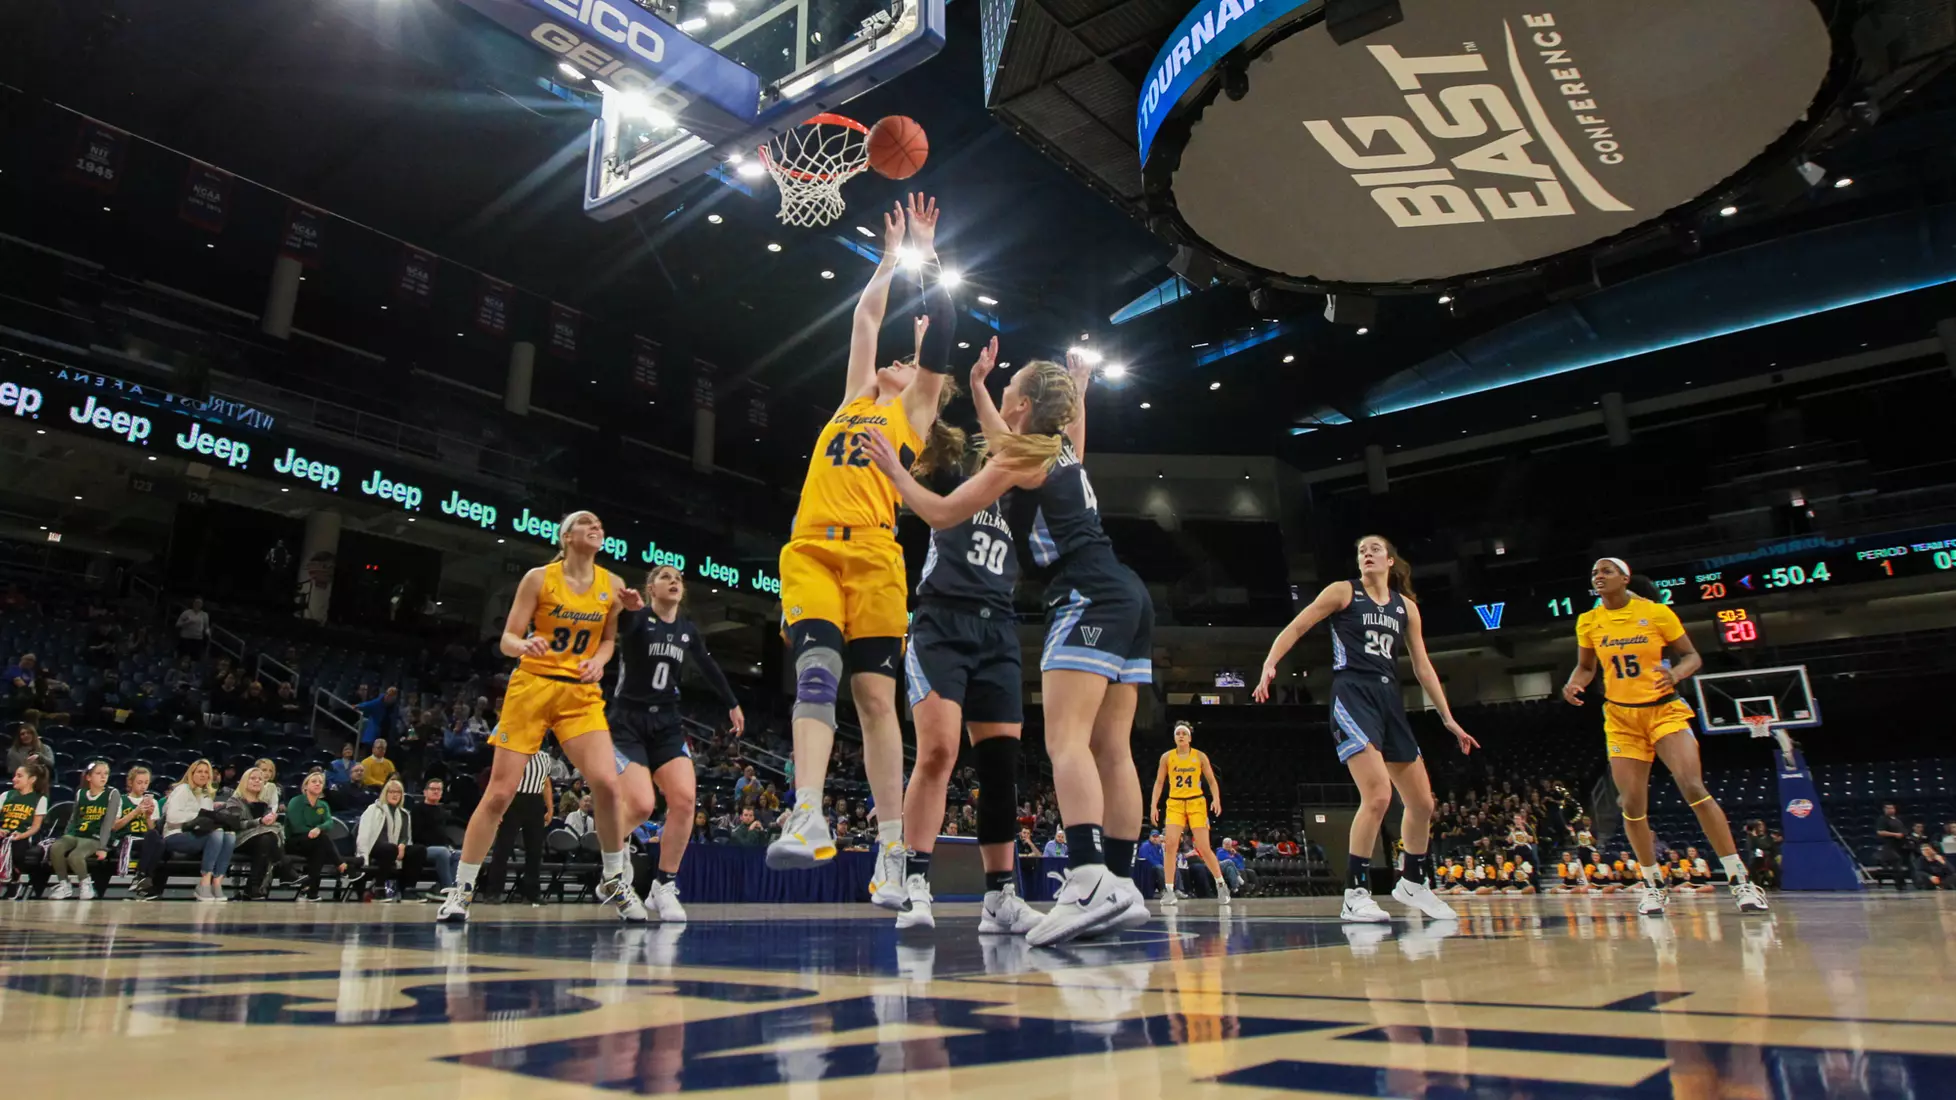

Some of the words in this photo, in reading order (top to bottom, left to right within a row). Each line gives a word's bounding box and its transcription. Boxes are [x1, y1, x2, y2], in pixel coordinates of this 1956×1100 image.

[531, 23, 690, 119] GEICO
[1522, 12, 1624, 165] CONFERENCE
[1366, 45, 1576, 220] EAST
[1303, 115, 1485, 228] BIG
[70, 396, 151, 443] Jeep
[177, 423, 250, 467] Jeep
[824, 431, 873, 467] 42
[274, 448, 341, 490] Jeep
[362, 470, 422, 510] Jeep
[441, 491, 497, 528] Jeep
[600, 536, 628, 561] ep
[642, 542, 686, 571] Jeep
[966, 530, 1008, 576] 30
[1856, 546, 1908, 561] PERIOD
[699, 556, 740, 588] Jeep
[1655, 576, 1686, 588] FOULS
[1695, 572, 1722, 583] SHOT
[1763, 561, 1831, 589] :50.4
[1880, 559, 1894, 576] 1
[752, 569, 781, 598] Jee
[1659, 588, 1675, 606] 2
[1700, 582, 1727, 600] 20
[1548, 596, 1573, 617] 11
[1362, 612, 1400, 634] VILLANOVA
[1725, 620, 1757, 642] 20
[550, 626, 591, 656] 30
[1364, 629, 1394, 660] 20
[1600, 634, 1648, 651] Marquette
[651, 660, 671, 691] 0
[1611, 653, 1640, 680] 15
[1175, 775, 1193, 788] 24
